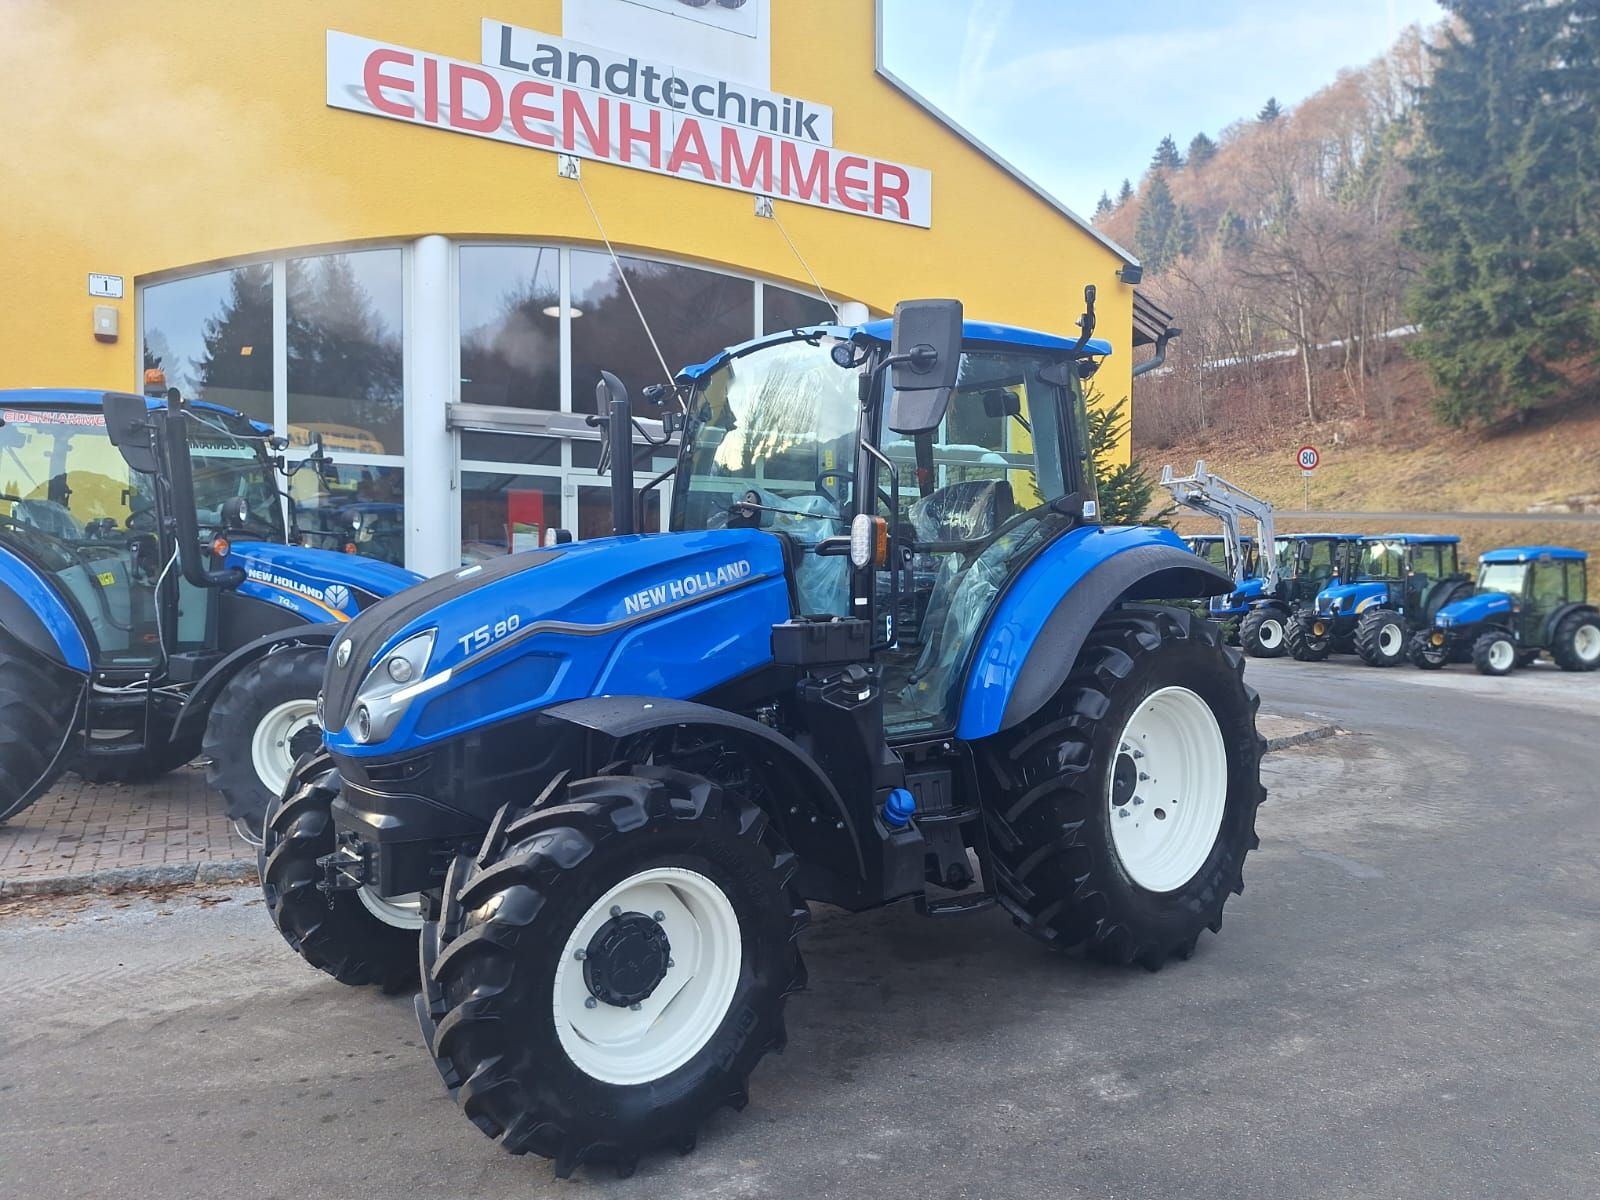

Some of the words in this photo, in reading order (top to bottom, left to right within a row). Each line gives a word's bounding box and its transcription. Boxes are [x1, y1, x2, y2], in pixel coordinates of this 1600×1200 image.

[499, 25, 820, 141] Landtechnik
[363, 47, 912, 221] EIDENHAMMER
[104, 280, 108, 292] 1
[4, 411, 105, 427] EIDENHAMME
[1302, 451, 1315, 465] 80
[248, 569, 272, 582] NEW
[273, 575, 324, 600] HOLLAND
[624, 586, 668, 614] NEW
[671, 559, 751, 600] HOLLAND
[459, 614, 520, 656] T5.80
